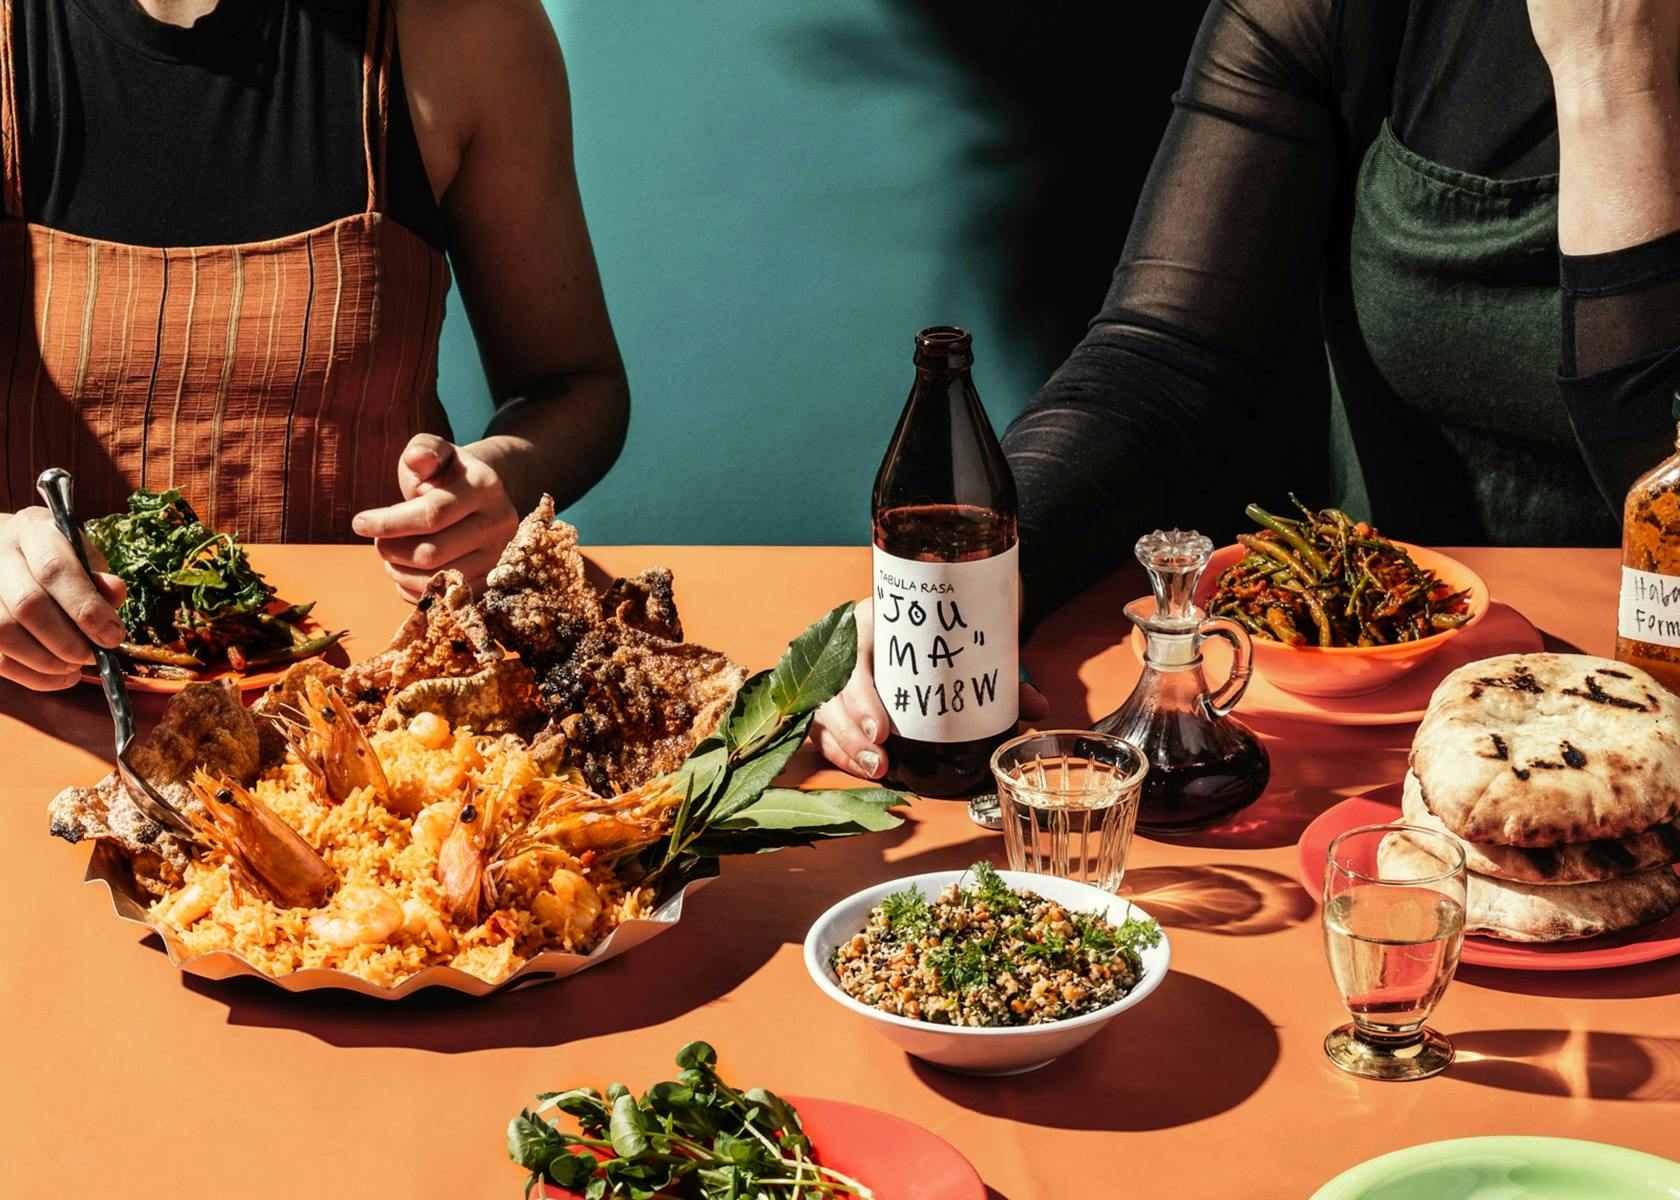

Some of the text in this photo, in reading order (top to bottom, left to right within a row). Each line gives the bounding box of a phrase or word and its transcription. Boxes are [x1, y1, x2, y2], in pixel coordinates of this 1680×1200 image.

[879, 570, 956, 594] TABULA RASA
[894, 668, 999, 717] #V18W
